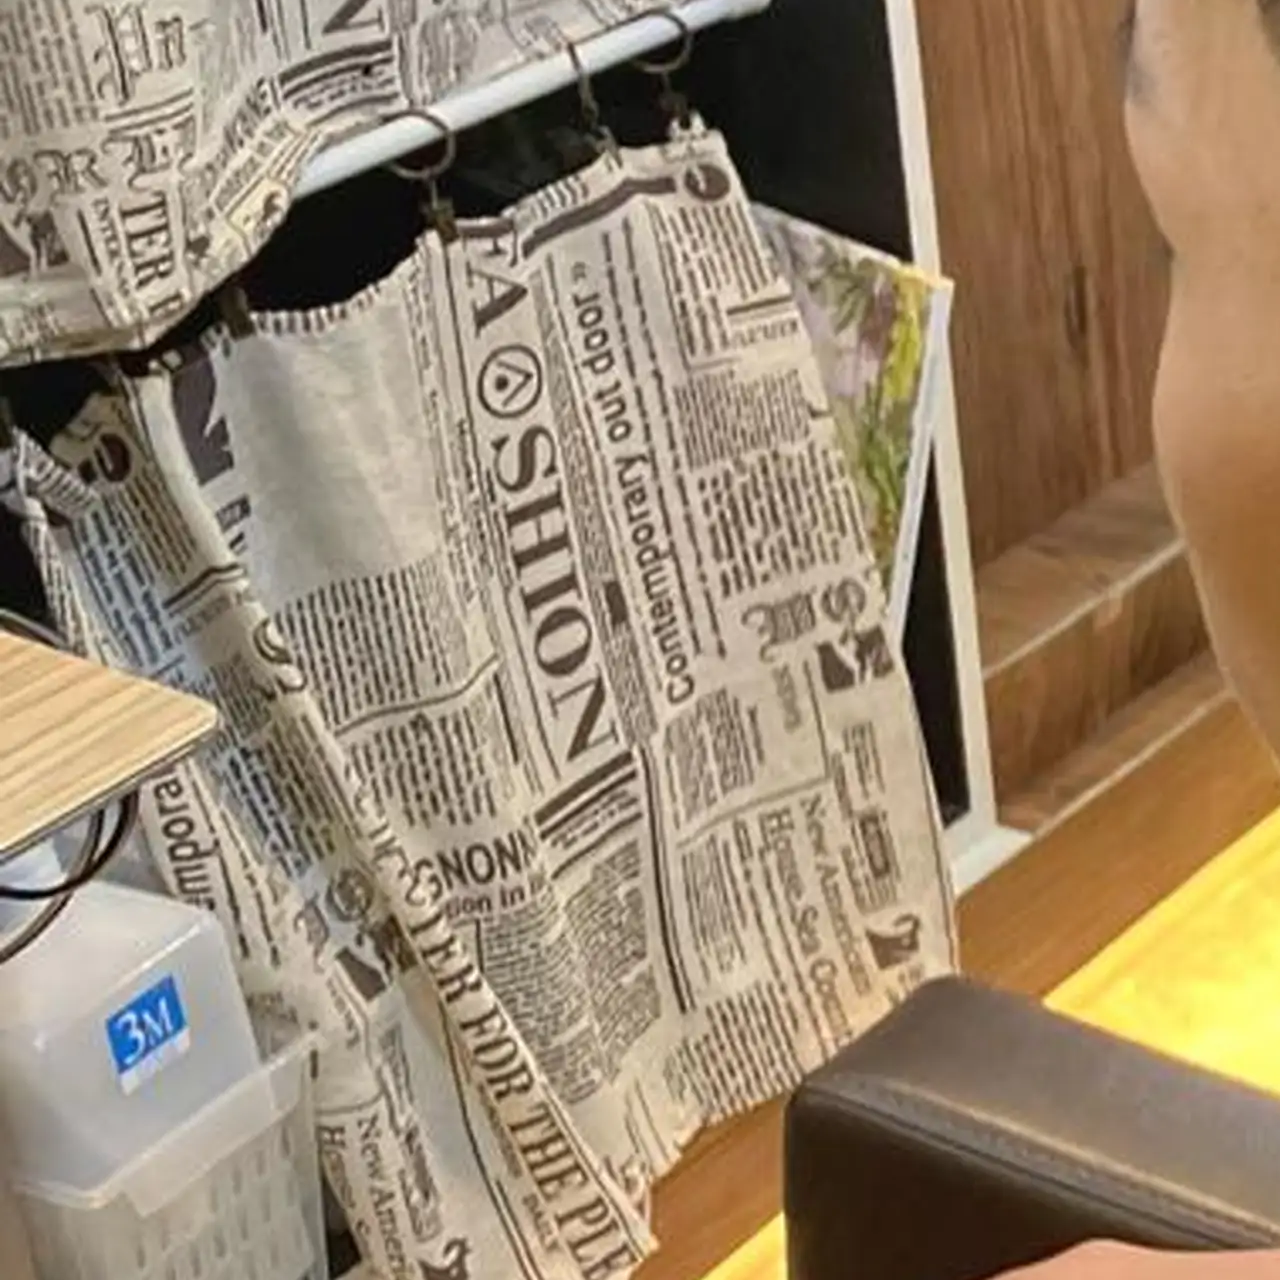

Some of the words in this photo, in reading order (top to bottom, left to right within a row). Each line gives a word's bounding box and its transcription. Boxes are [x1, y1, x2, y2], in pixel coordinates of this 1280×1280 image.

[571, 290, 616, 377] door
[594, 379, 633, 444] out
[614, 450, 697, 706] Contemporary
[111, 1006, 176, 1065] 3M
[461, 1003, 536, 1101] FOR
[510, 1100, 590, 1200] THE
